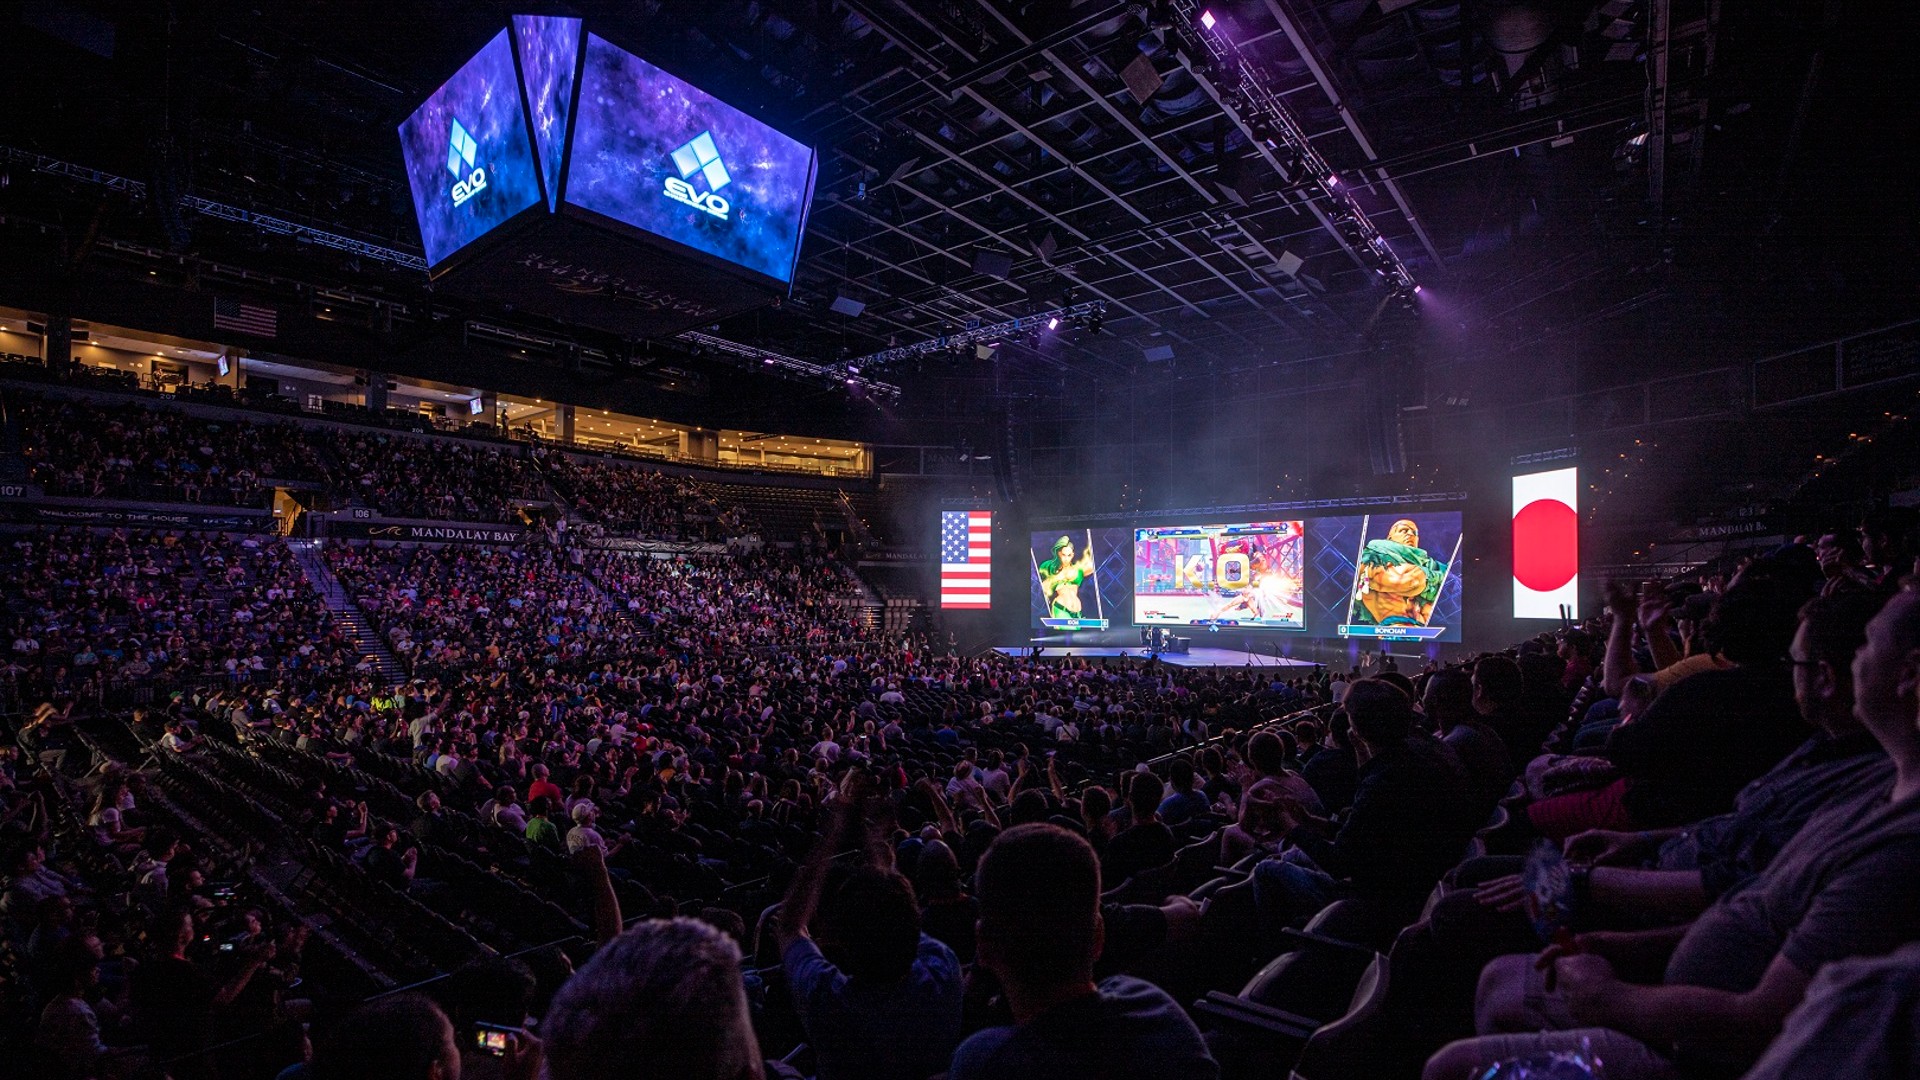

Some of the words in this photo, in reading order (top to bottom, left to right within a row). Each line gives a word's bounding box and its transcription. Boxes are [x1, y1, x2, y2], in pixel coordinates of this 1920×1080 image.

[452, 167, 485, 202] EVO
[664, 176, 729, 215] EVO
[0, 485, 24, 497] 107
[39, 508, 103, 518] WELCOME
[107, 512, 123, 520] TO
[126, 513, 149, 521] THE
[355, 508, 370, 518] 106
[411, 527, 490, 540] MANDALAY
[494, 532, 516, 542] BAY
[1699, 522, 1754, 537] MANDALAY
